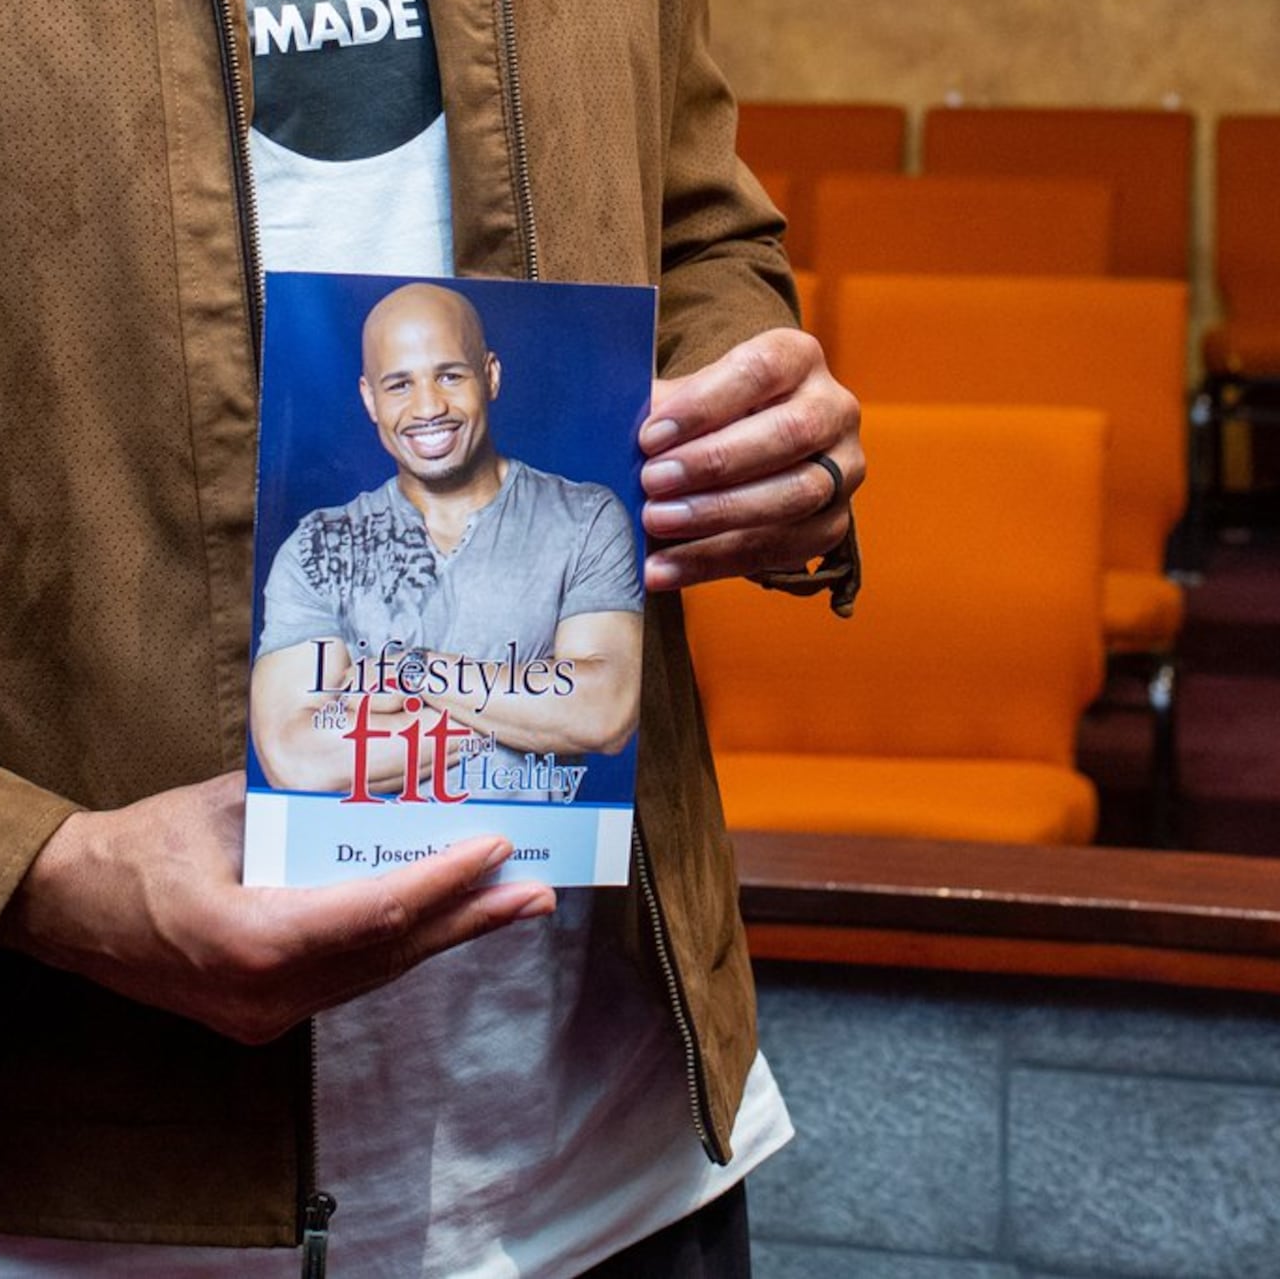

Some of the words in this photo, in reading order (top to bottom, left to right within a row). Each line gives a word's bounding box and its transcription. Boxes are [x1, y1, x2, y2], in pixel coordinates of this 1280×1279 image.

[307, 640, 576, 714] Lifestyles
[325, 697, 348, 715] of
[313, 709, 347, 731] the
[340, 677, 472, 804] fit
[459, 732, 497, 754] and
[458, 753, 587, 803] Healthy
[336, 844, 367, 862] Dr.
